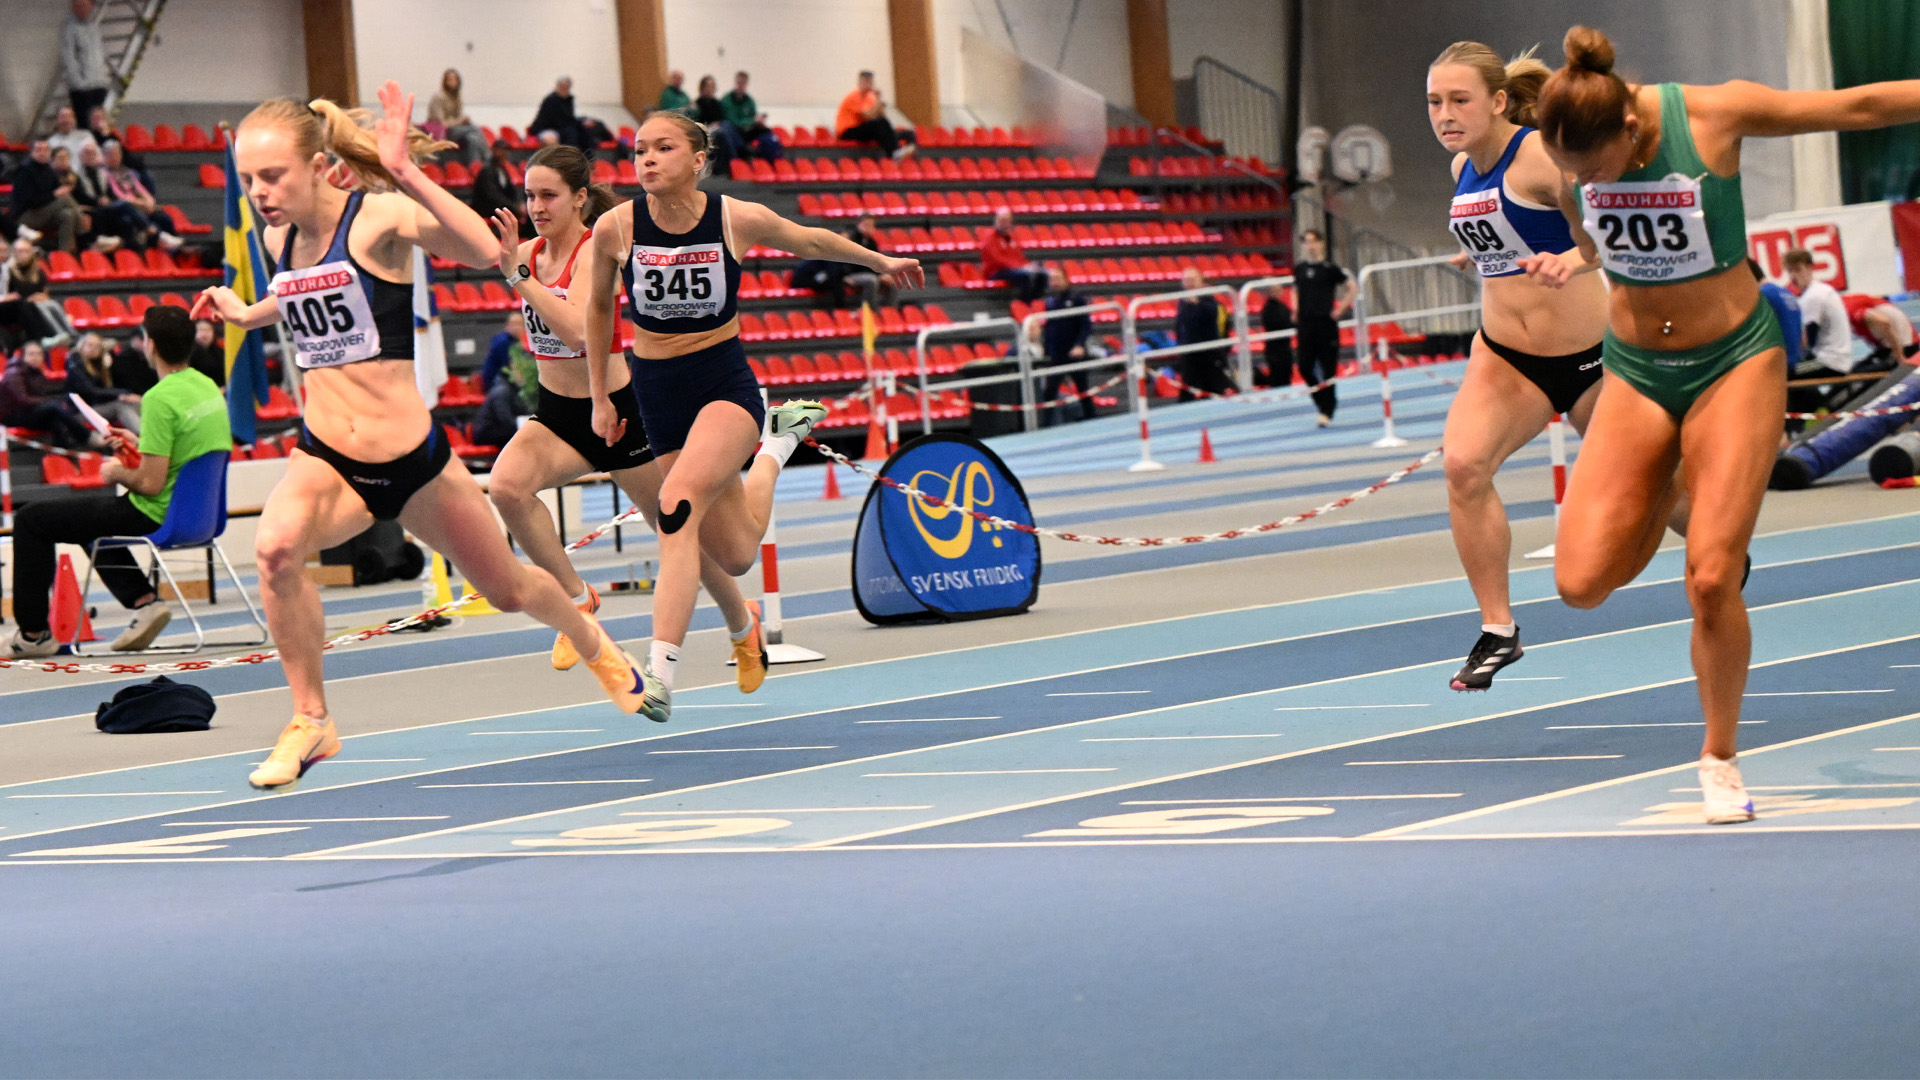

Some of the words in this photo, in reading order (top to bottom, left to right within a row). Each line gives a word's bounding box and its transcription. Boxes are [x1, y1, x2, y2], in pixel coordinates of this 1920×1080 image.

[1602, 192, 1693, 207] BAUHAUS
[1451, 200, 1496, 216] BAUHAUS
[1454, 219, 1505, 252] 169
[1598, 213, 1688, 253] 203
[649, 252, 718, 265] BAUHAUS
[1608, 252, 1697, 267] MICROPOWER
[1627, 267, 1674, 278] GROUP
[277, 271, 351, 295] BAUHAUS
[644, 267, 711, 302] 345
[644, 302, 717, 311] MICROPOWER
[660, 310, 698, 318] GROUP
[286, 293, 355, 337] 405
[310, 350, 346, 364] GROUP
[911, 568, 974, 593] SVENSK
